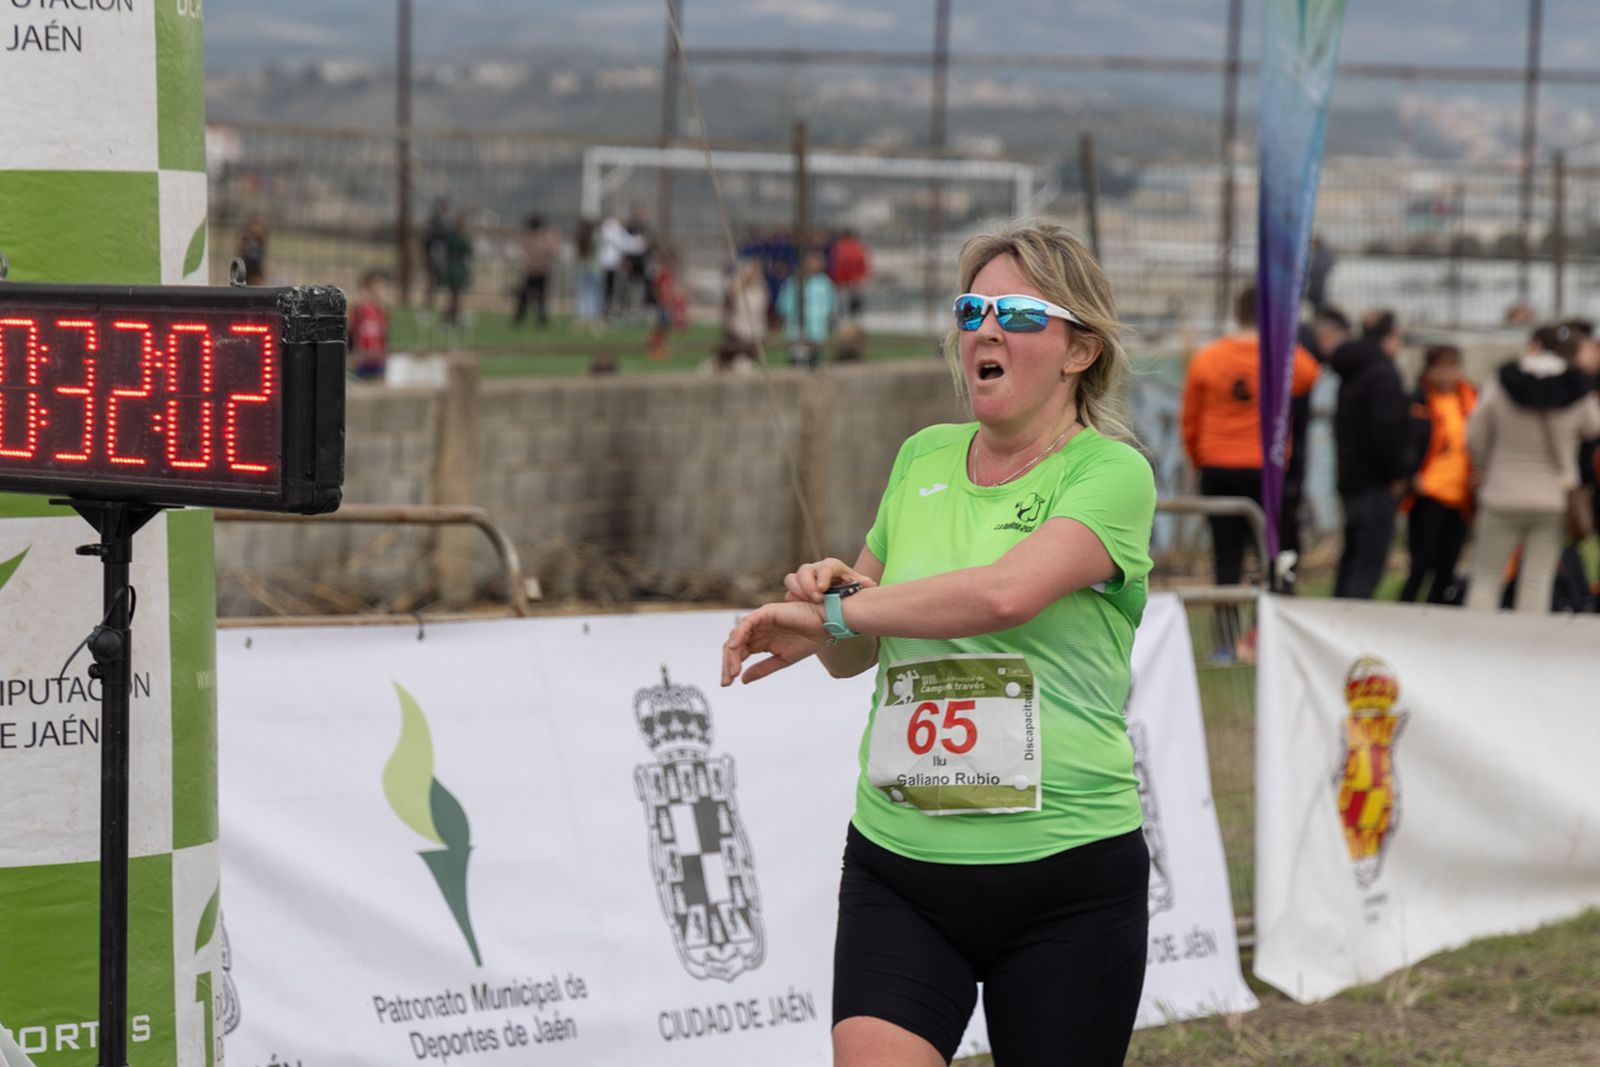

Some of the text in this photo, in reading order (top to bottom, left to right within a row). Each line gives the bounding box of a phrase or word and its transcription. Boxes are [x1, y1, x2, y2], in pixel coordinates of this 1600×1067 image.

[6, 19, 82, 52] JAÉN
[0, 671, 151, 706] IPUTACN
[24, 713, 99, 749] JAÉN
[907, 700, 978, 756] 65
[955, 772, 1001, 786] Rubio
[372, 972, 589, 1024] Patronato Municipal de
[657, 986, 818, 1042] CIUDAD DE JAÉN
[409, 1010, 578, 1066] Deportes de Jaén
